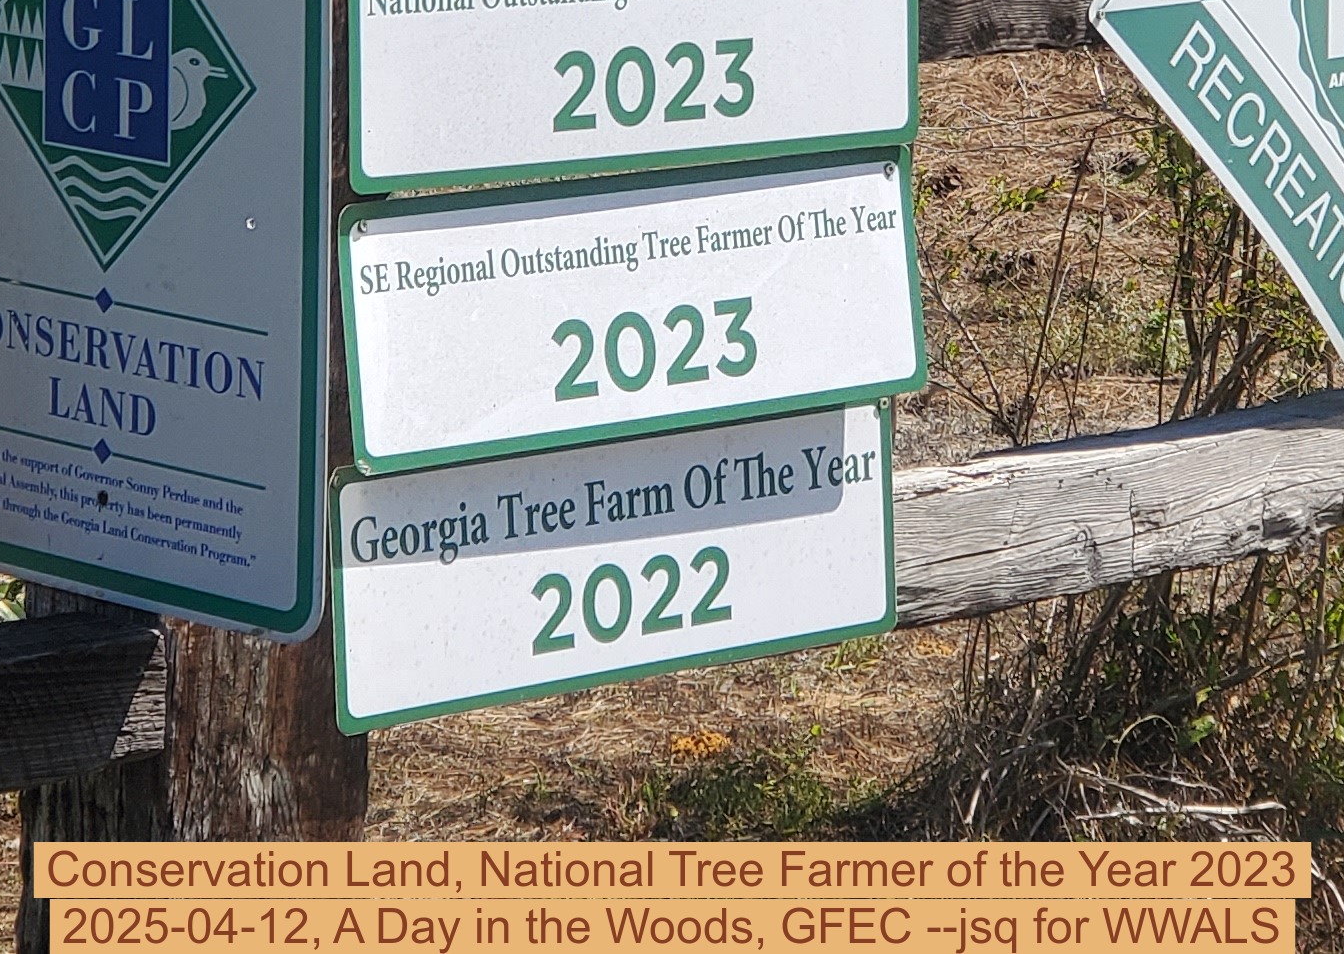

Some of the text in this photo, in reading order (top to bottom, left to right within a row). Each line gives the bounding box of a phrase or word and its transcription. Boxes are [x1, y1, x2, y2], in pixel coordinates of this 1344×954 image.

[552, 37, 755, 133] 2023
[359, 205, 898, 298] SE Regional Outstanding Tree Farmer Of The Year
[550, 297, 757, 403] 2023
[48, 376, 157, 437] LAND
[2, 449, 18, 465] the
[20, 456, 58, 475] support
[61, 463, 73, 477] of
[74, 465, 124, 488] Governor
[126, 476, 160, 501] Sonny
[162, 485, 200, 505] Perdue
[203, 496, 223, 511] and
[226, 500, 244, 516] the
[3, 497, 41, 521] through
[43, 508, 59, 521] the
[61, 511, 100, 534] Georgia
[102, 520, 128, 539] Land
[130, 527, 197, 555] Conservation
[9, 474, 58, 501] Assembly,
[59, 487, 78, 503] this
[127, 501, 145, 519] has
[147, 506, 173, 524] been
[175, 516, 242, 544] permanently
[350, 446, 876, 565] Georgia Tree Farm Of The Year
[530, 546, 733, 656] 2022
